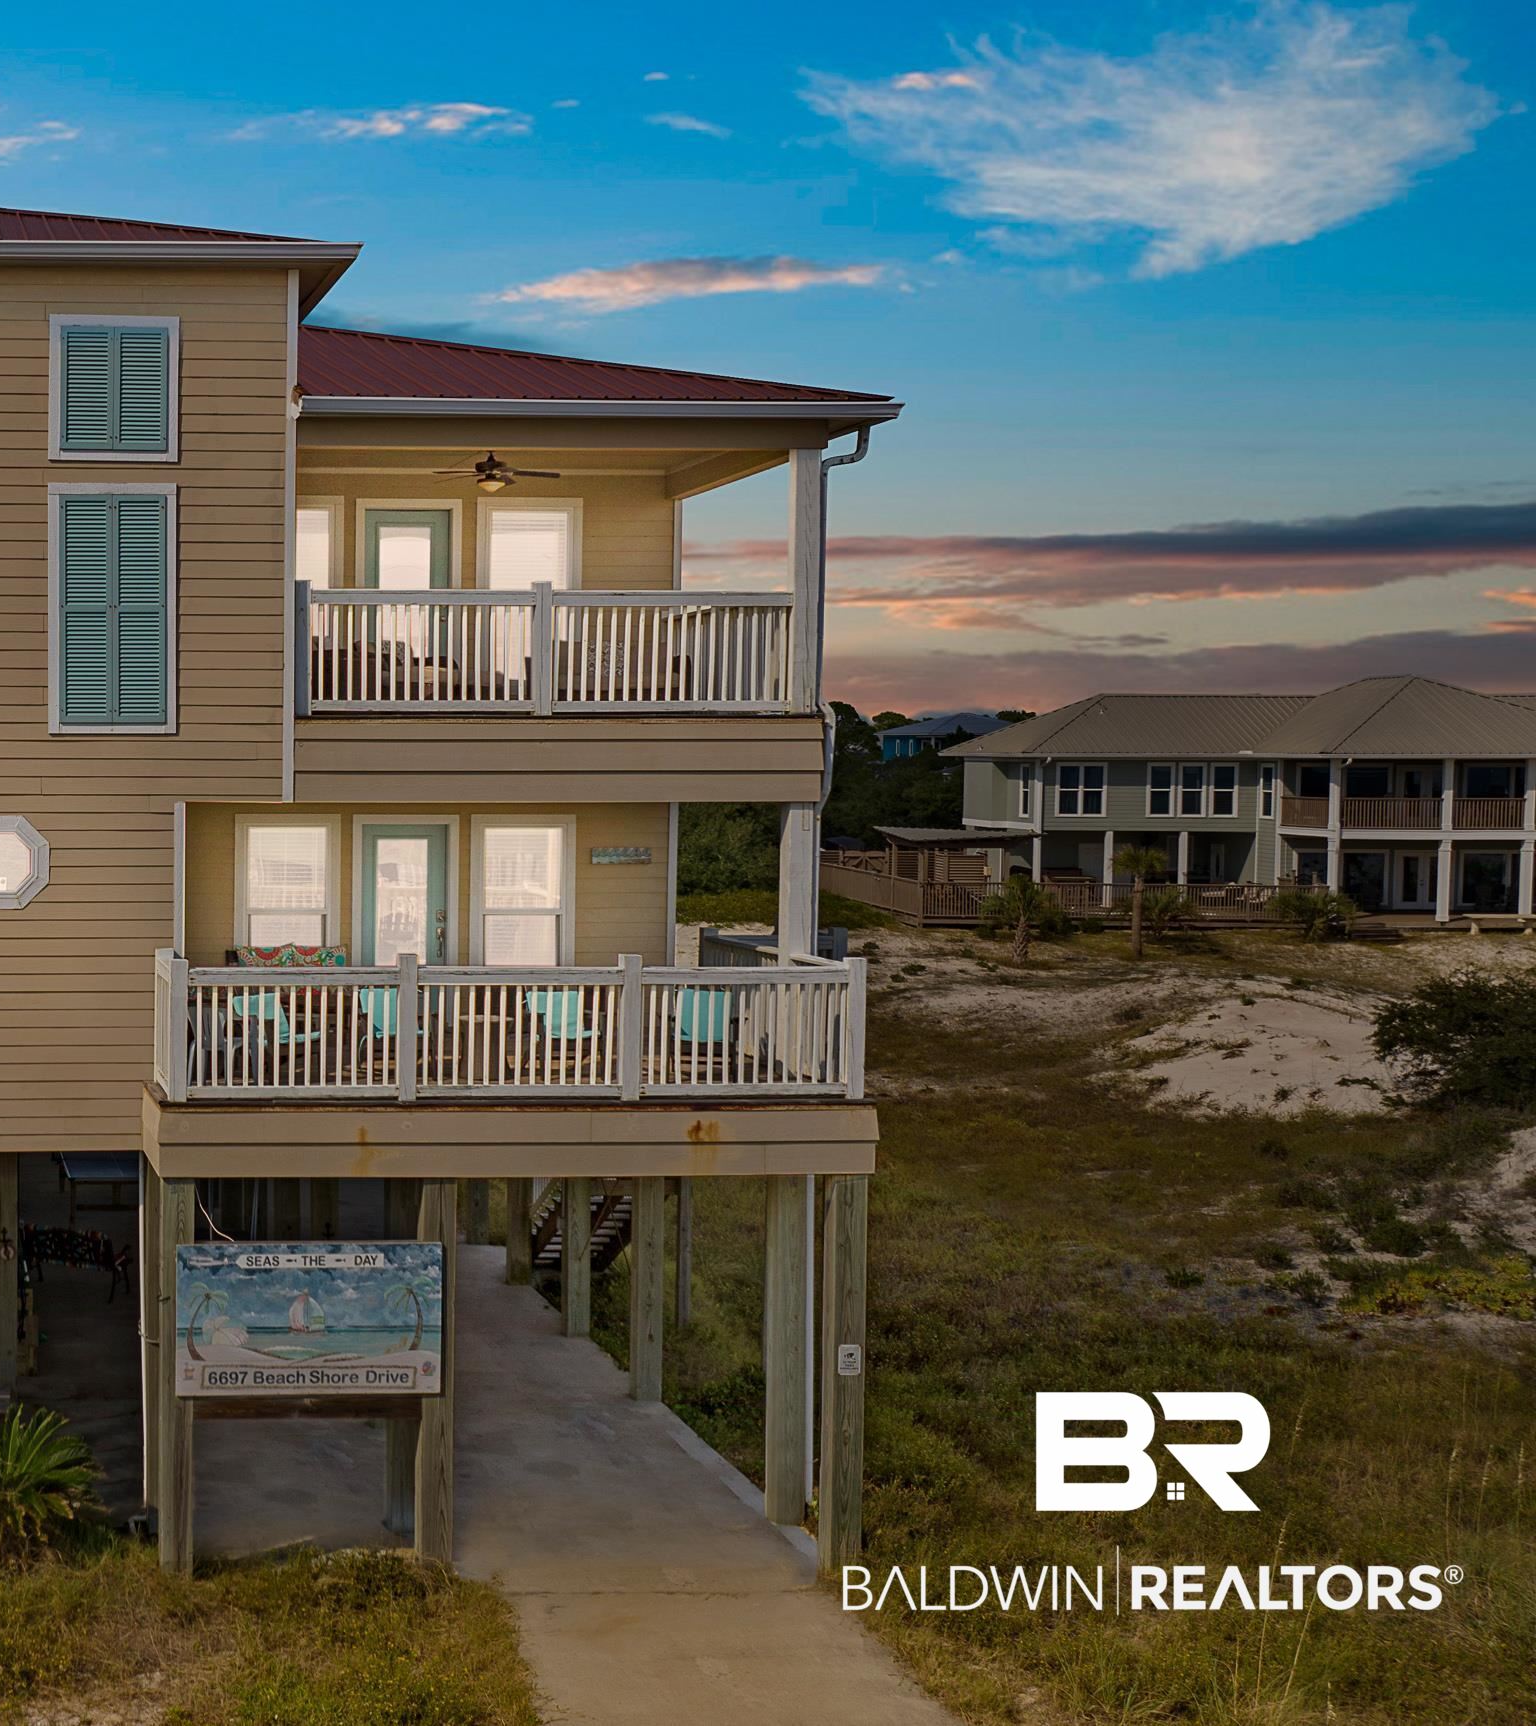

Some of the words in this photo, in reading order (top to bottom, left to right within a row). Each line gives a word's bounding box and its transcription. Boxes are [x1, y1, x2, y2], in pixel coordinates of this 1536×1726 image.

[246, 1255, 280, 1267] SEAS
[301, 1255, 326, 1267] THE
[354, 1254, 378, 1267] DAY
[208, 1371, 248, 1386] 6697
[253, 1370, 306, 1385] Beach
[309, 1370, 360, 1384] Shore
[365, 1369, 410, 1384] Drive
